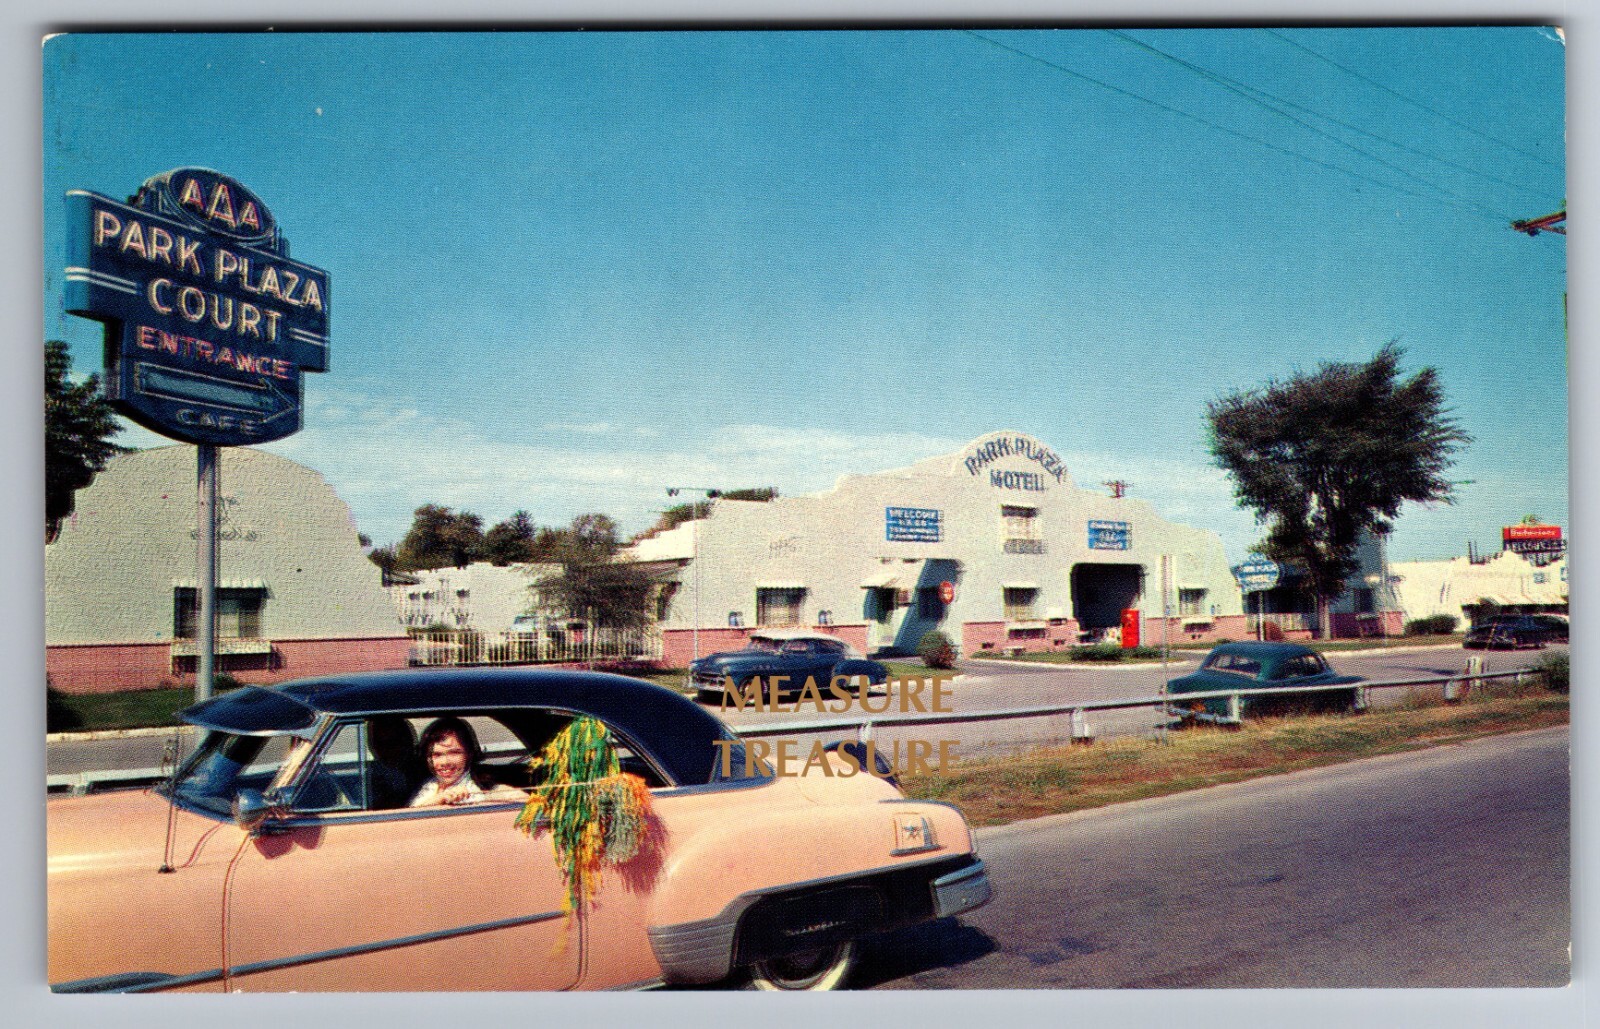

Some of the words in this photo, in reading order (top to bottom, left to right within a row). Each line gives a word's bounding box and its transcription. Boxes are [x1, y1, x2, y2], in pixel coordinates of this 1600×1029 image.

[179, 179, 260, 230] AAA
[94, 209, 202, 276] PARK
[215, 249, 323, 312] PLAZA
[149, 277, 283, 342] COURT
[137, 325, 291, 380] ENTRANCE
[176, 408, 261, 435] CAFE
[965, 437, 1010, 476] PARK
[1015, 437, 1065, 484] PLAZA
[990, 469, 1043, 491] MOTEL
